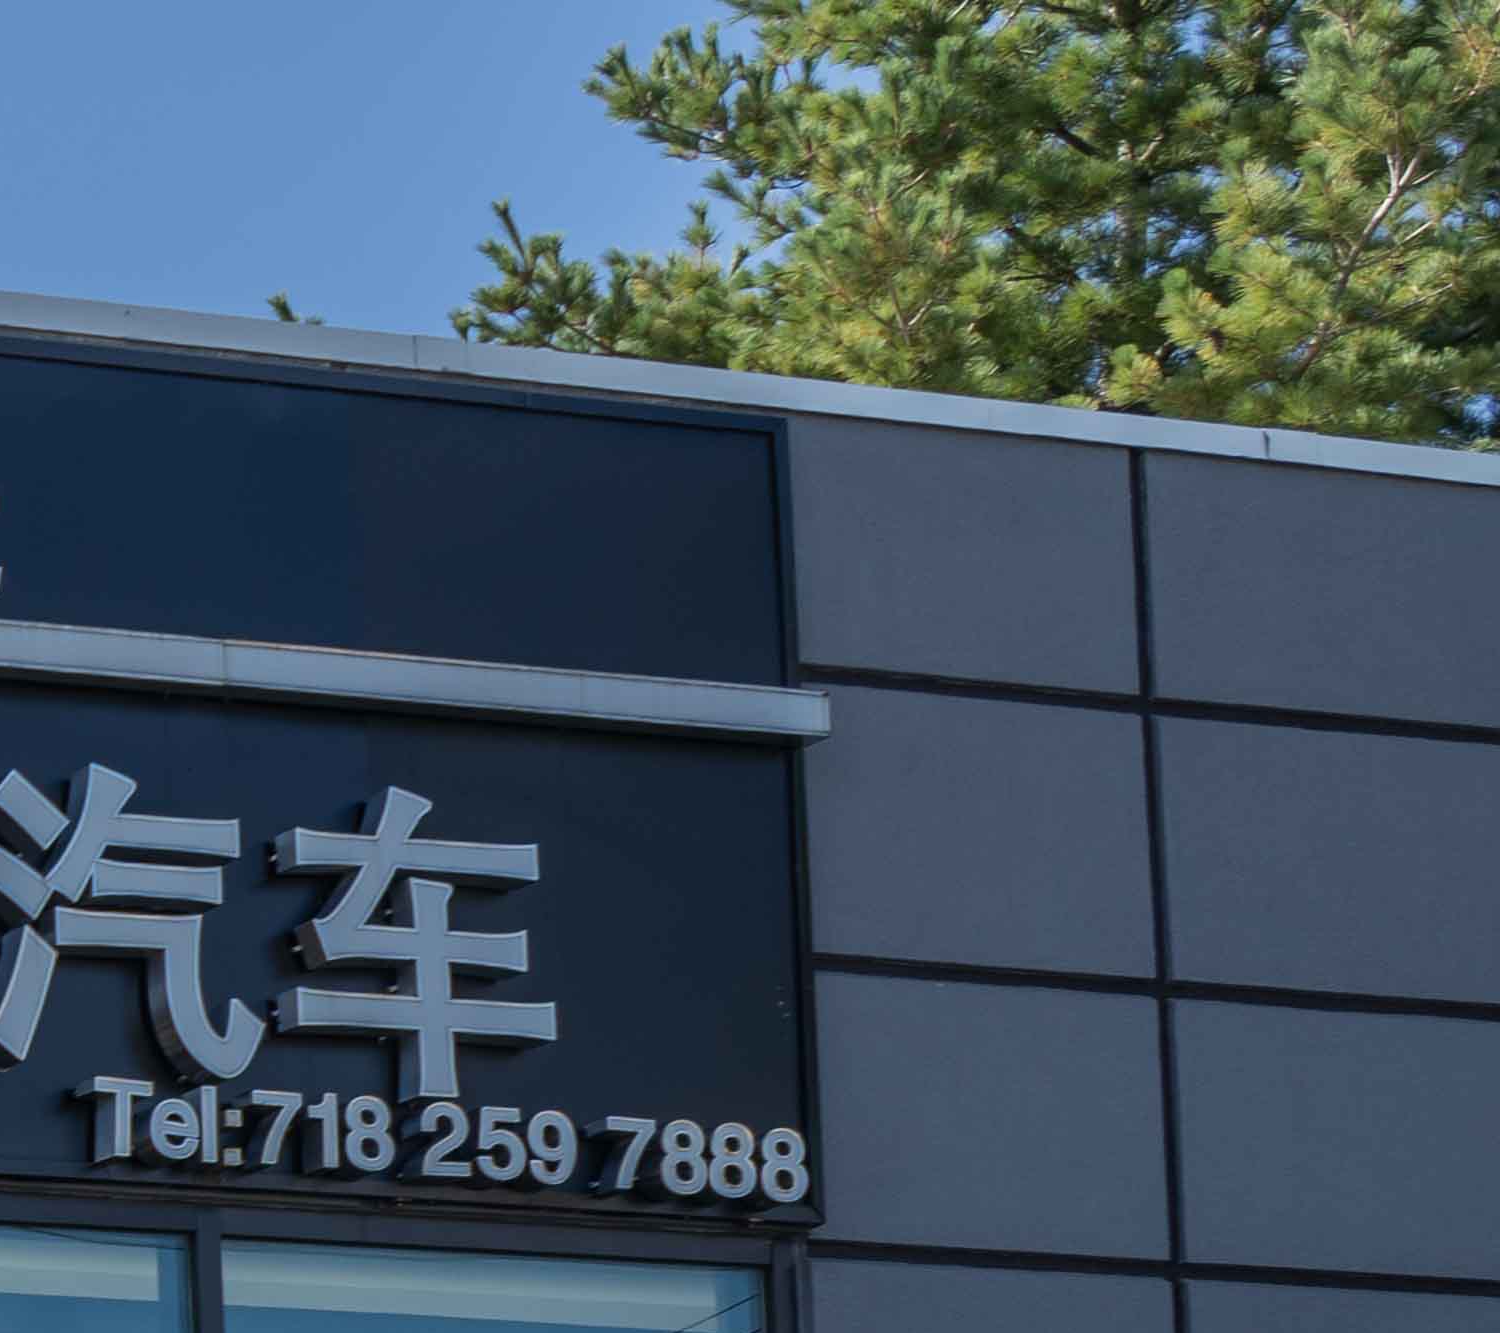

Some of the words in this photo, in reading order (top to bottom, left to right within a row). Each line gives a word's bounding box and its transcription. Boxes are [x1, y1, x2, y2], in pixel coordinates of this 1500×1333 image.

[87, 1075, 397, 1172] Tel:718
[418, 1101, 579, 1186] 259
[603, 1116, 809, 1203] 7888
